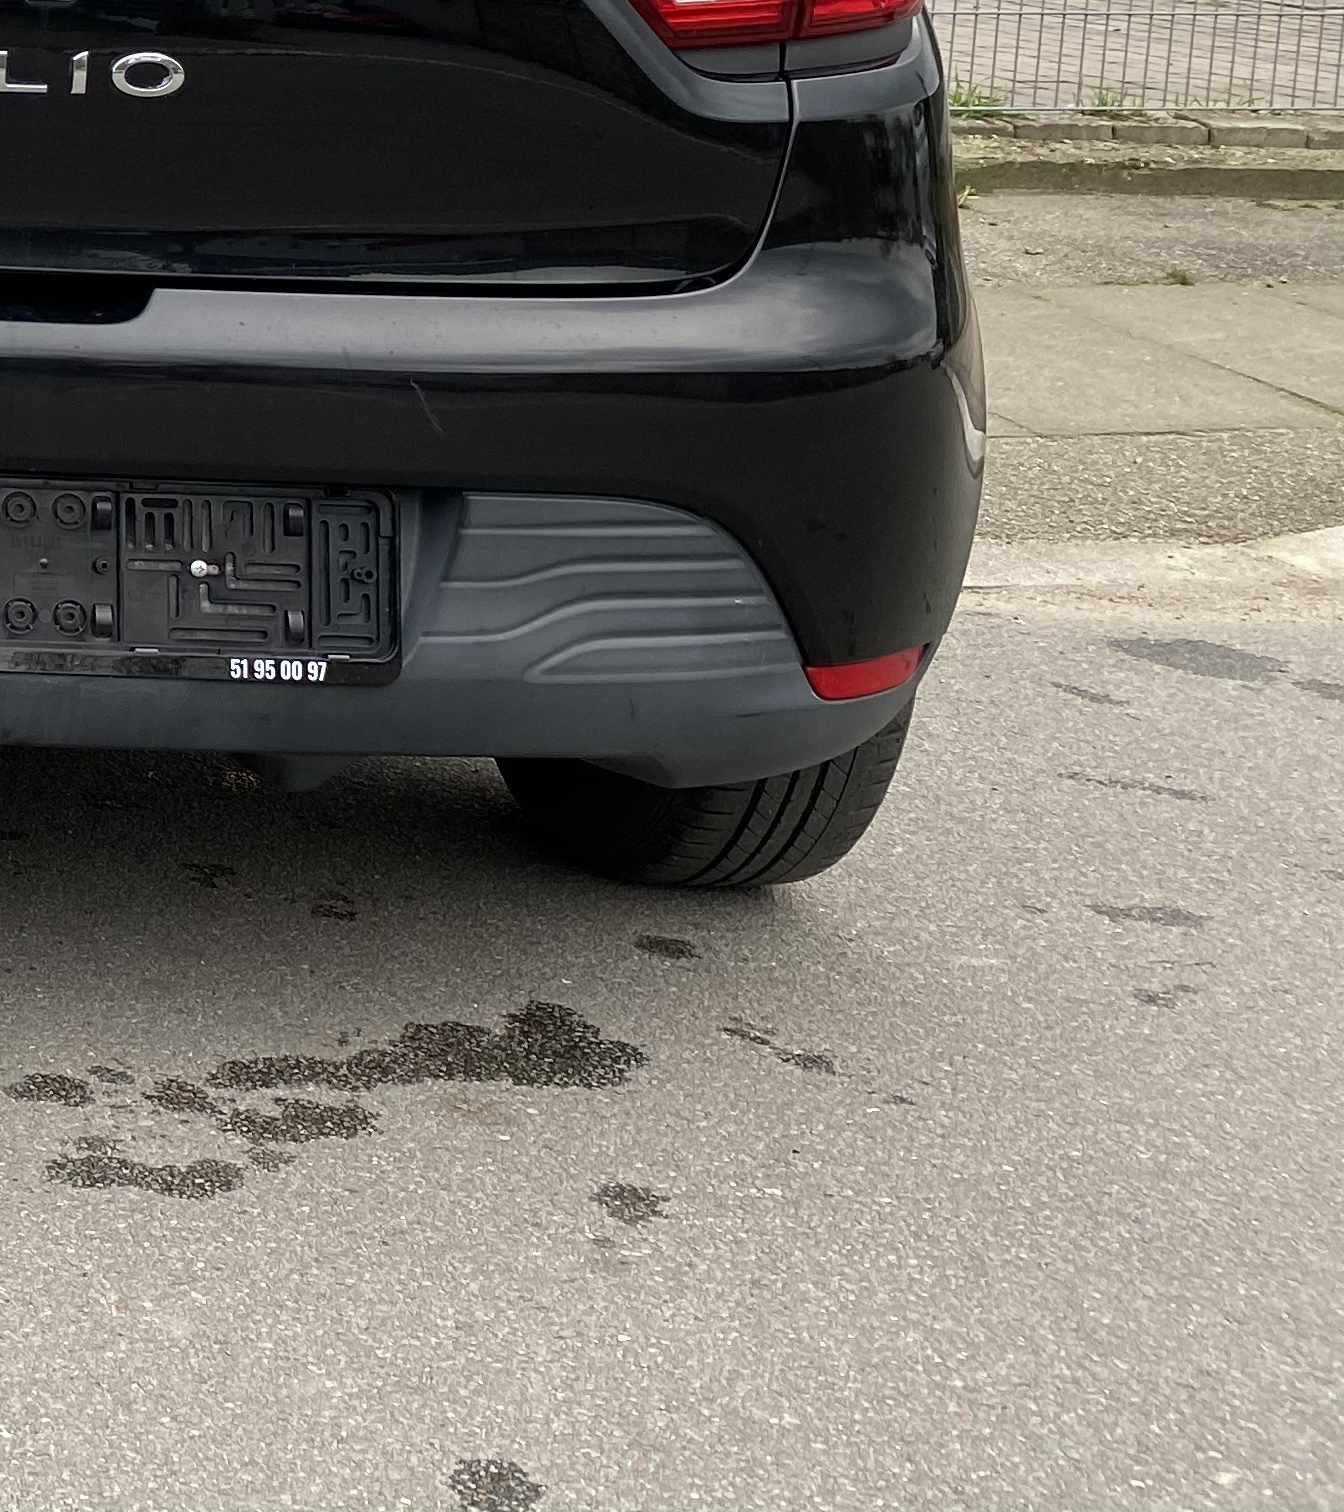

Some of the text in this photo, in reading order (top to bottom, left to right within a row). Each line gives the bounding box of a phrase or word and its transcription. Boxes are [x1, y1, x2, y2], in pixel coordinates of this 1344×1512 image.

[230, 658, 327, 682] 51 95 00 97
